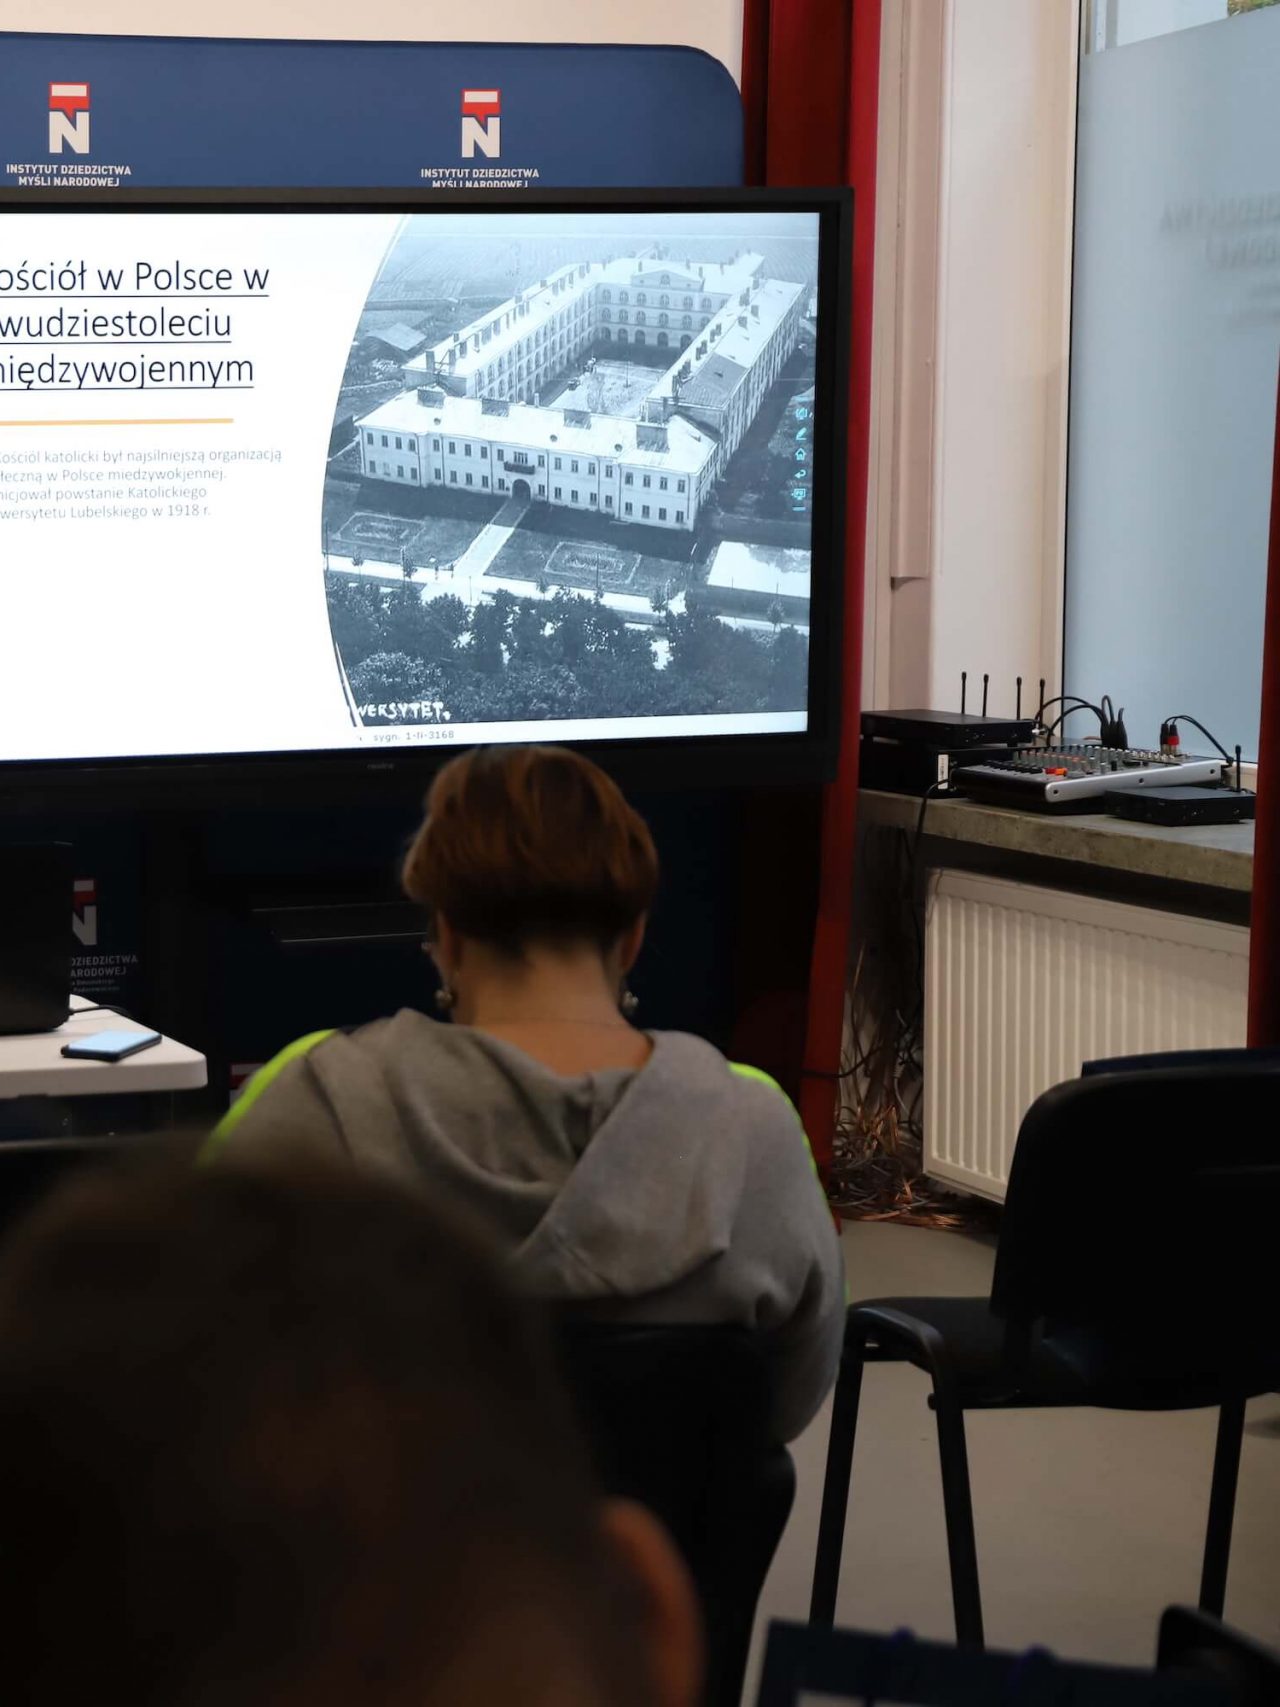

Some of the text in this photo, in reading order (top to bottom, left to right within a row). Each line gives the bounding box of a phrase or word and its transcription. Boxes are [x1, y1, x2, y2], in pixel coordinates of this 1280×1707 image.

[6, 164, 132, 175] INSTYTUT DZIEDZICTWA
[420, 168, 540, 178] INSTYTUT DZIEDZICTWA
[18, 174, 120, 187] MYŚLI NARODOWEJ
[97, 268, 124, 291] w
[135, 260, 233, 291] Polsce
[243, 268, 270, 290] w
[44, 450, 99, 464] katolicki
[103, 449, 123, 464] był
[127, 448, 206, 465] najsilniejszą
[209, 447, 283, 464] organizacją
[47, 472, 58, 482] w
[62, 468, 105, 482] Polsce
[56, 487, 124, 502] powstanie
[128, 485, 208, 501] Katolickiego
[71, 505, 148, 520] Lubelskiego
[152, 507, 164, 517] w
[168, 504, 200, 517] 1918
[70, 966, 127, 977] ARODOWEJ
